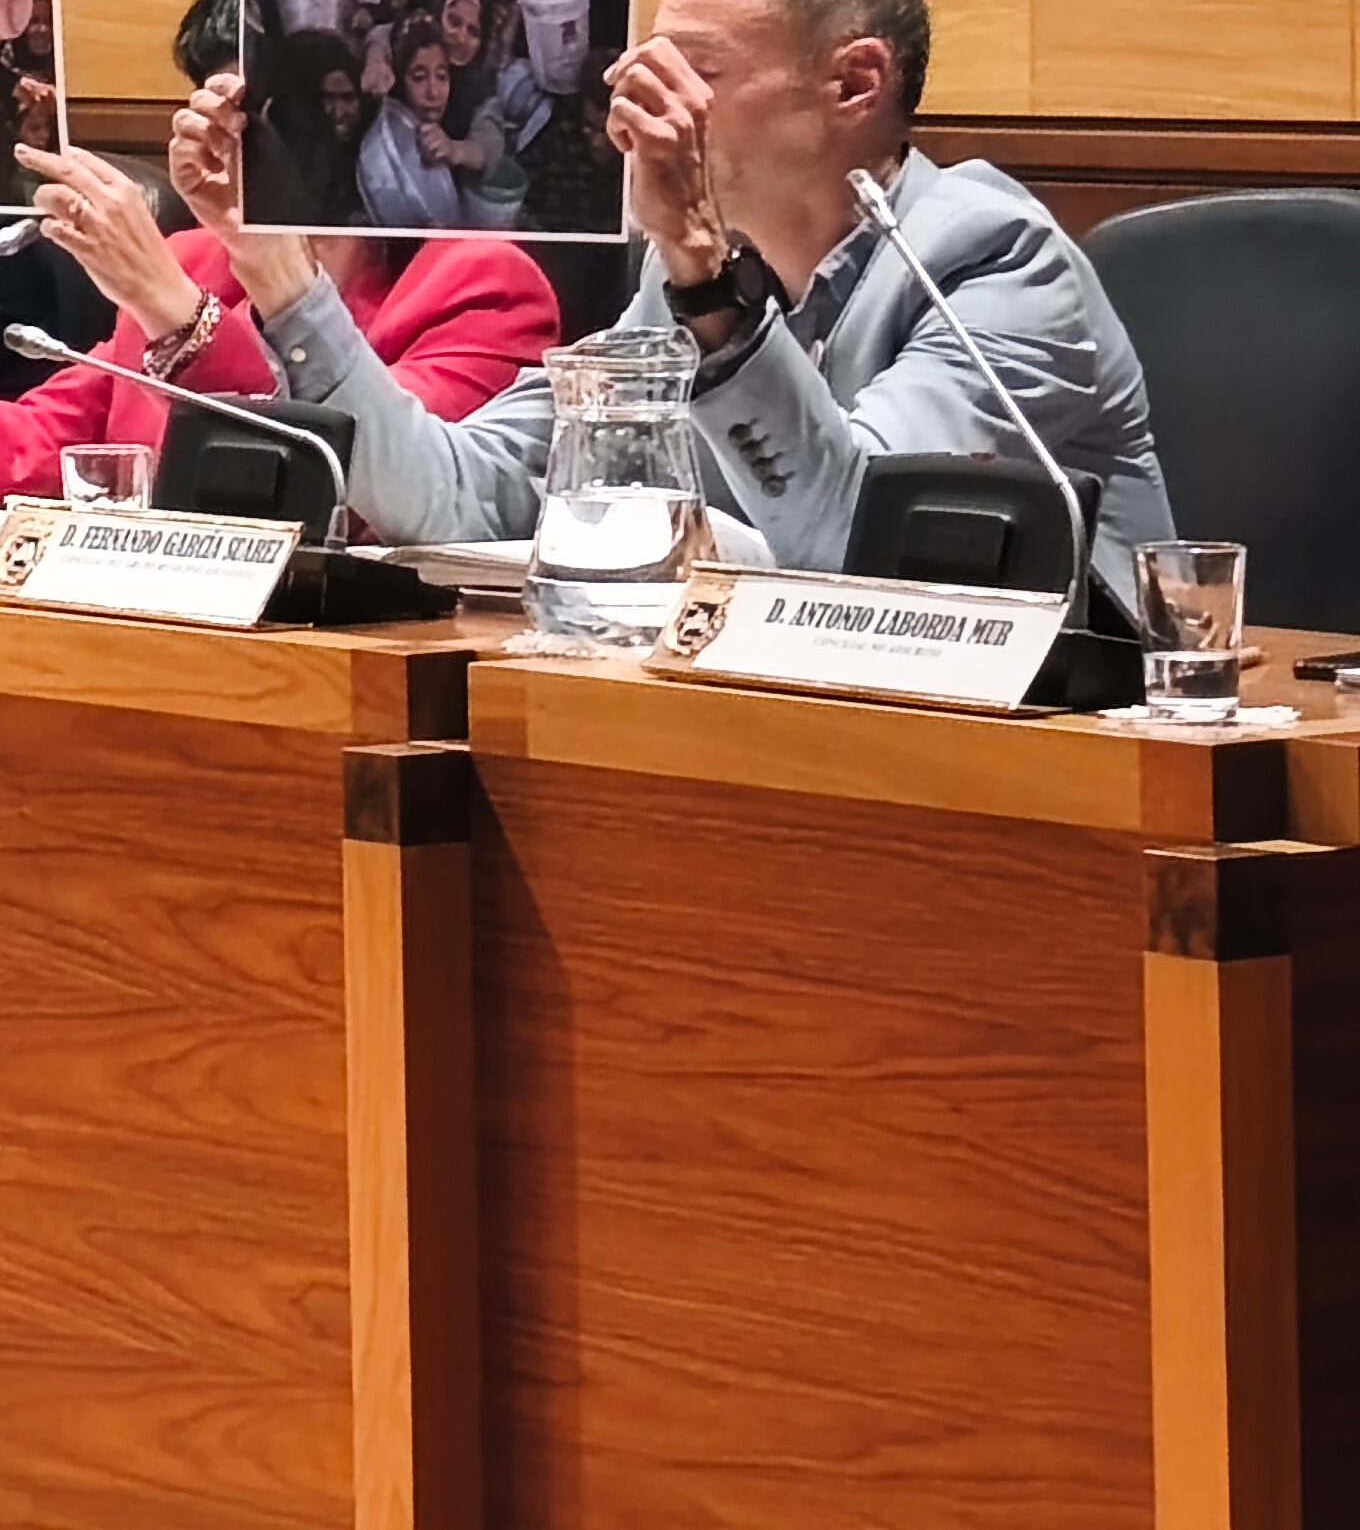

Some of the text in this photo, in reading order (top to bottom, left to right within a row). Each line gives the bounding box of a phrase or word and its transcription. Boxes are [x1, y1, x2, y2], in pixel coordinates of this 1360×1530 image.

[60, 524, 77, 548] D.
[79, 525, 164, 554] FERNANDO
[765, 597, 1015, 646] D. ANTONIO LABORDA MUR
